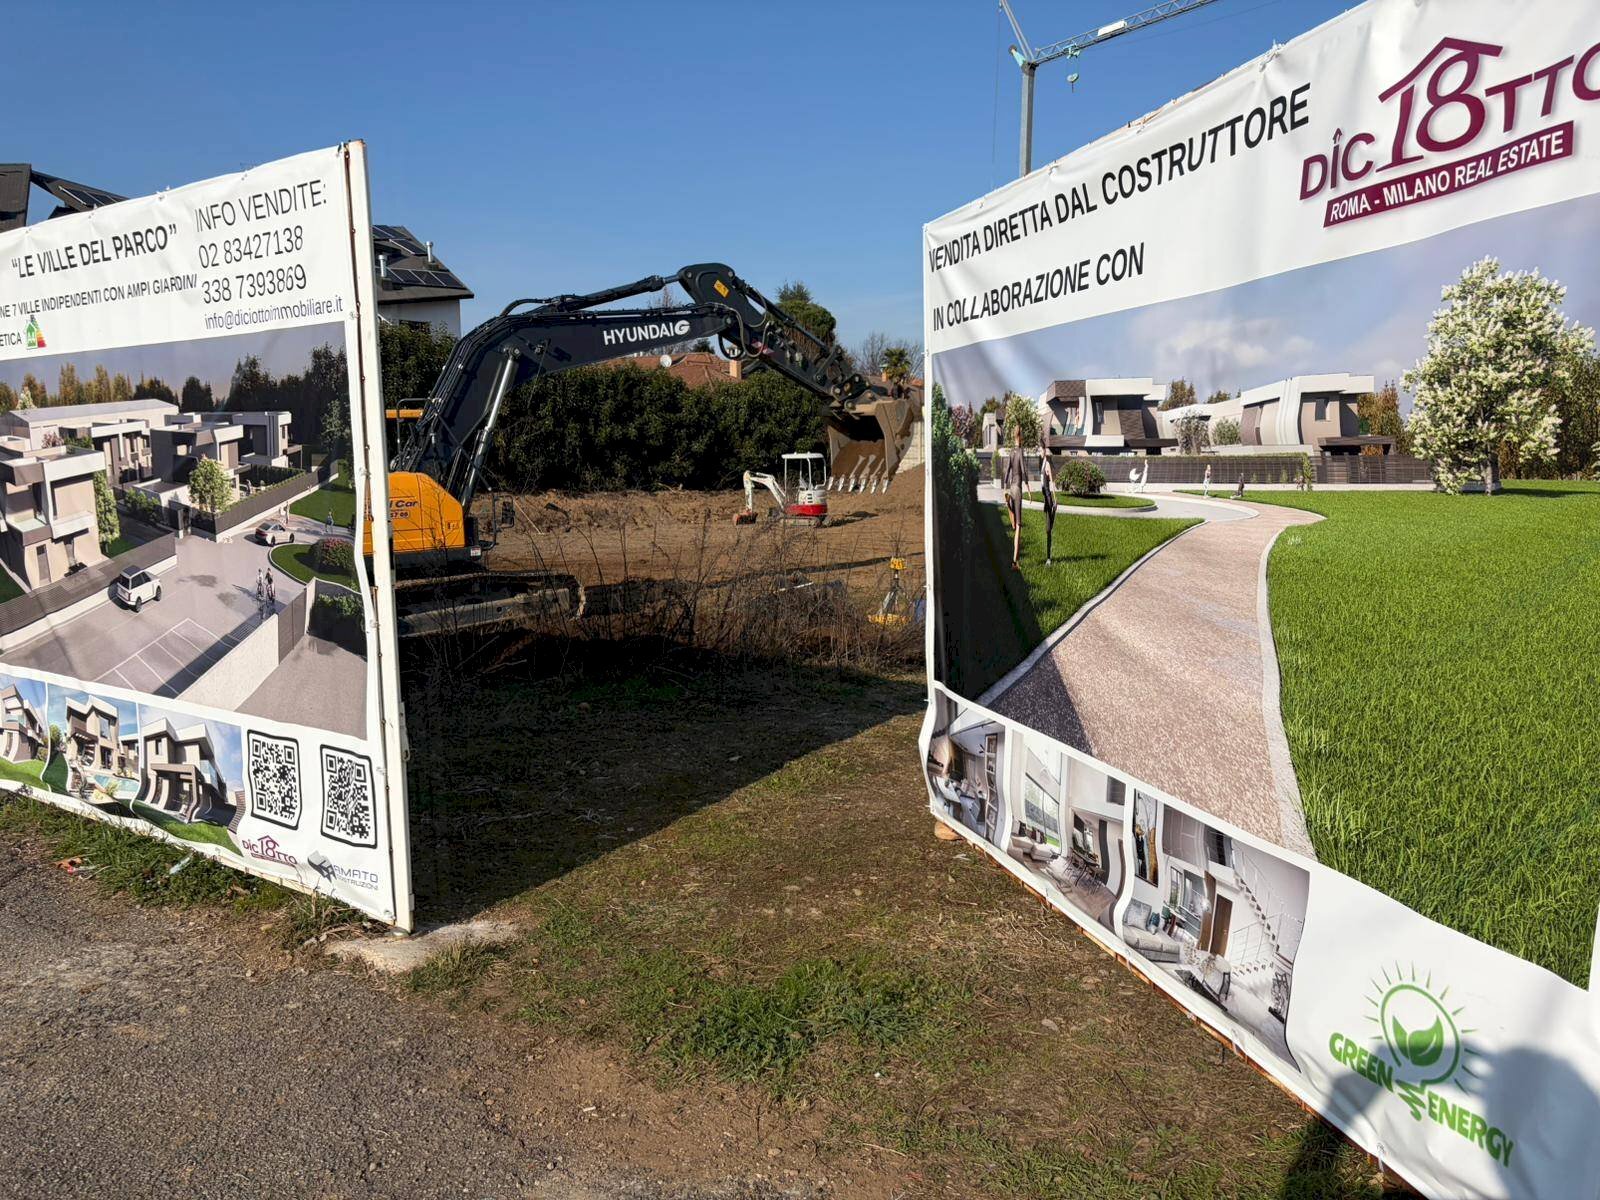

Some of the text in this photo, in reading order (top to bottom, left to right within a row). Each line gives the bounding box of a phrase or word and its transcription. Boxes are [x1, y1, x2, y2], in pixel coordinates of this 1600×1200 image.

[929, 82, 1311, 273] VENDITA DIRETTA DAL COSTRUTTORE
[1330, 194, 1371, 222] ROMA
[1383, 170, 1450, 207] MILANO
[1454, 156, 1494, 188] REAL
[1497, 130, 1564, 173] ESTATE
[195, 180, 327, 233] INFO VENDITE:
[37, 245, 78, 274] VILLE
[78, 239, 111, 266] DEL
[199, 225, 303, 269] 02 83427138
[18, 299, 40, 315] VILLE
[41, 289, 102, 312] INDIPENDENTI
[103, 285, 126, 302] CON
[127, 281, 151, 298] AMPI
[152, 273, 198, 295] GIARDINI
[201, 264, 307, 304] 338 7393869
[933, 242, 1145, 331] IN COLLABORAZIONE CON
[603, 321, 674, 346] HYUNDAI
[1328, 1032, 1515, 1168] GREEN ENERGY
